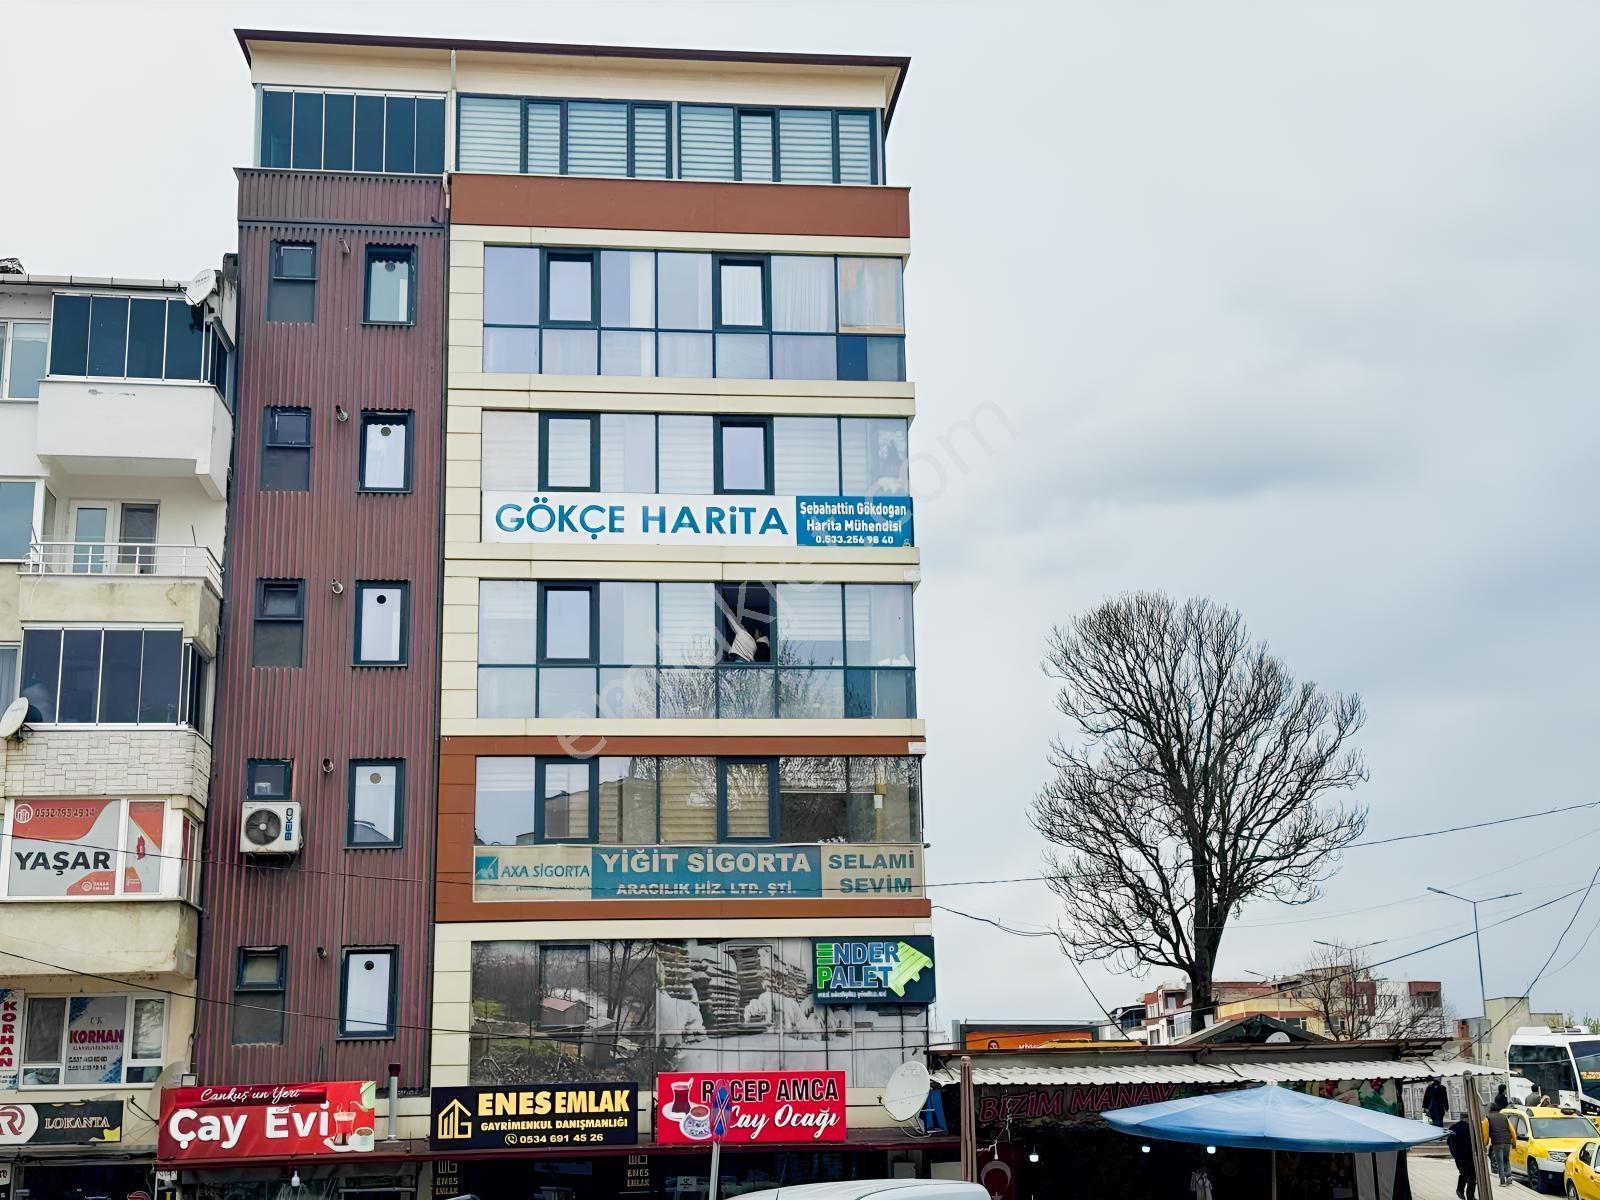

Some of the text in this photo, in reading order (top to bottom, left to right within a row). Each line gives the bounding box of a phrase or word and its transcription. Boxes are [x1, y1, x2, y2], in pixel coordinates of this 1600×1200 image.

[495, 496, 625, 540] GÖKÇE
[800, 501, 855, 516] Sebahattin
[807, 519, 842, 532] Harita
[284, 807, 294, 841] BEKO
[15, 850, 110, 876] YAŞAR
[501, 865, 530, 878] AXA
[600, 848, 812, 874] YİĞİT SİGORTA
[828, 850, 915, 870] SELAMİ
[839, 875, 913, 894] SEVİM
[816, 965, 893, 989] PALET
[69, 1029, 125, 1044] KORHAN
[701, 1078, 839, 1103] RCEP AMCA
[1070, 1084, 1176, 1114] MANAV
[478, 1090, 630, 1116] ENES EMLAK
[44, 1117, 110, 1129] LOKANTA
[169, 1100, 330, 1149] Çay Evi
[481, 1116, 628, 1131] GAYRİMENKUL DANIŞMANLIĞI
[774, 1104, 840, 1139] Ocağı
[519, 1133, 604, 1144] 0534 691 45 26
